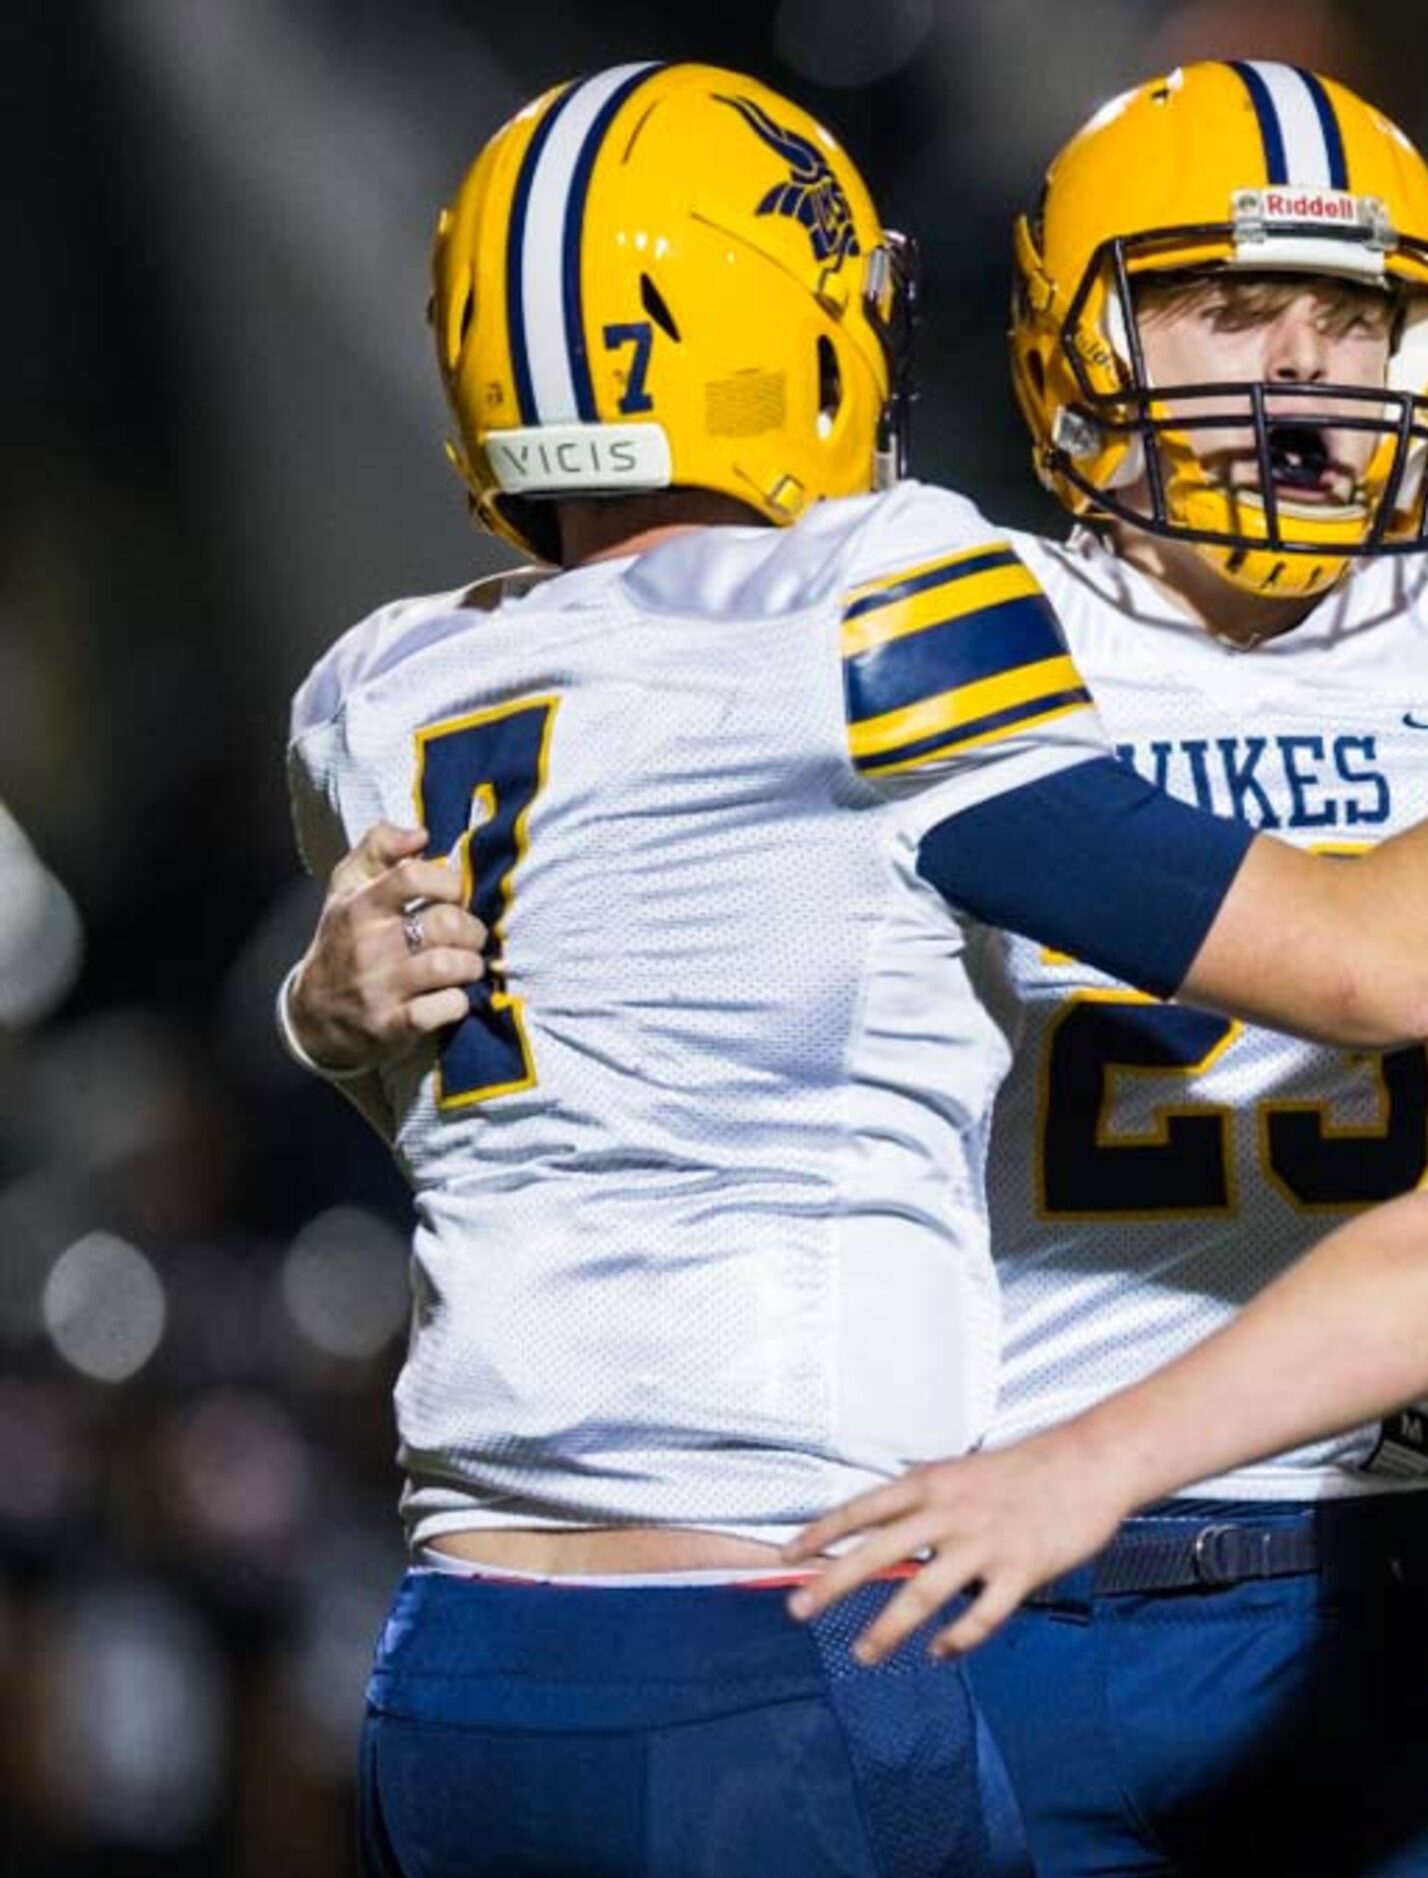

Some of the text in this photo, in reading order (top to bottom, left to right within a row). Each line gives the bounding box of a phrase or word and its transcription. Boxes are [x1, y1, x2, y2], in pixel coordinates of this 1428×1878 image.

[1266, 194, 1354, 219] Riddell
[602, 321, 654, 415] 7
[501, 440, 637, 476] VICIS
[413, 695, 562, 1111] 7
